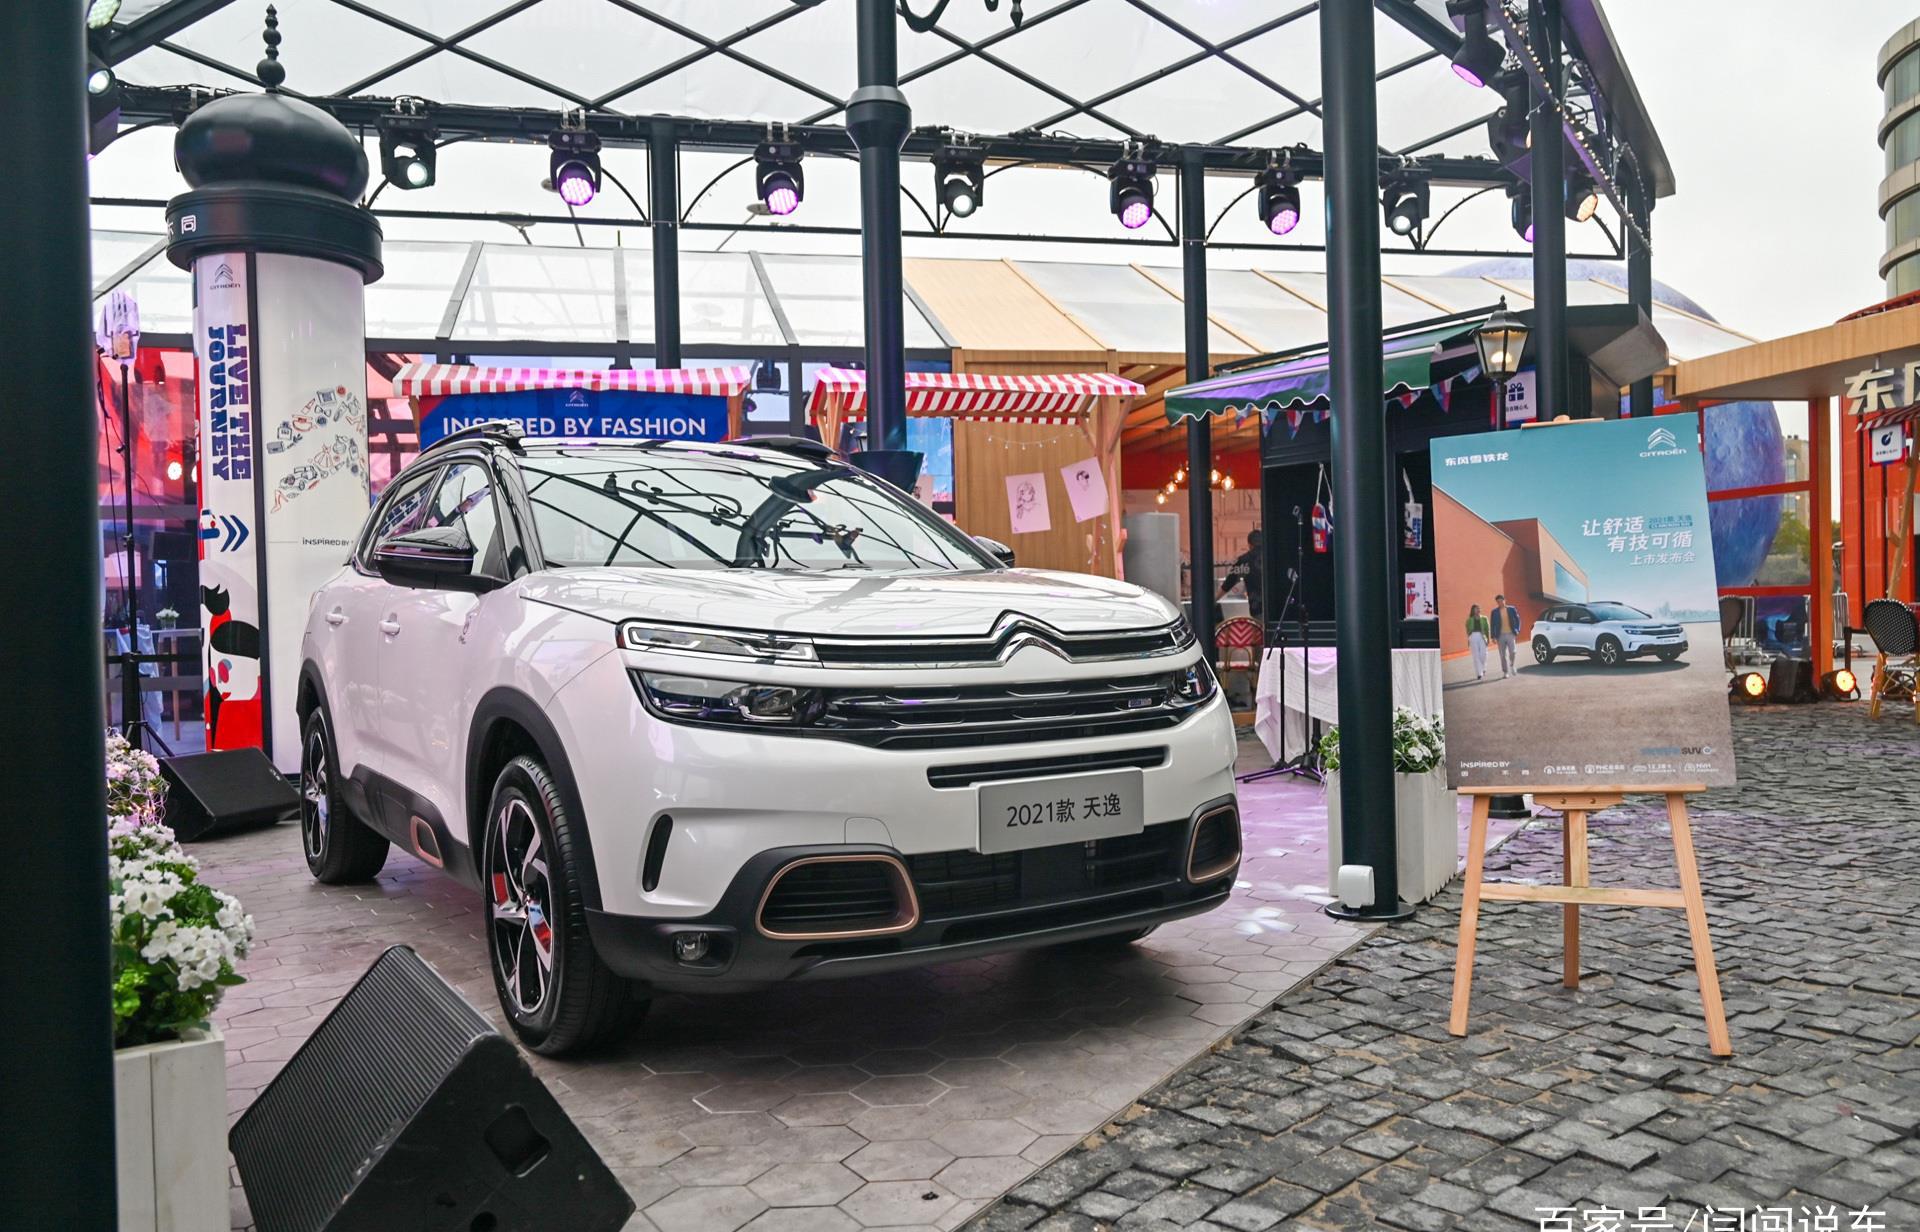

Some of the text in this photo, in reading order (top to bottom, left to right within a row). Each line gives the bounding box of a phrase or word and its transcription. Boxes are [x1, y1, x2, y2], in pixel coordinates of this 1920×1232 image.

[208, 326, 229, 480] JOURNEY
[227, 324, 251, 479] LIVE THE
[564, 418, 593, 435] BY
[601, 418, 706, 435] FASHION
[1582, 516, 1644, 537] 让舒适
[1607, 531, 1693, 553] 有技可循
[1630, 551, 1696, 566] 上市发布会
[1006, 793, 1121, 828] 2021款 天逸
